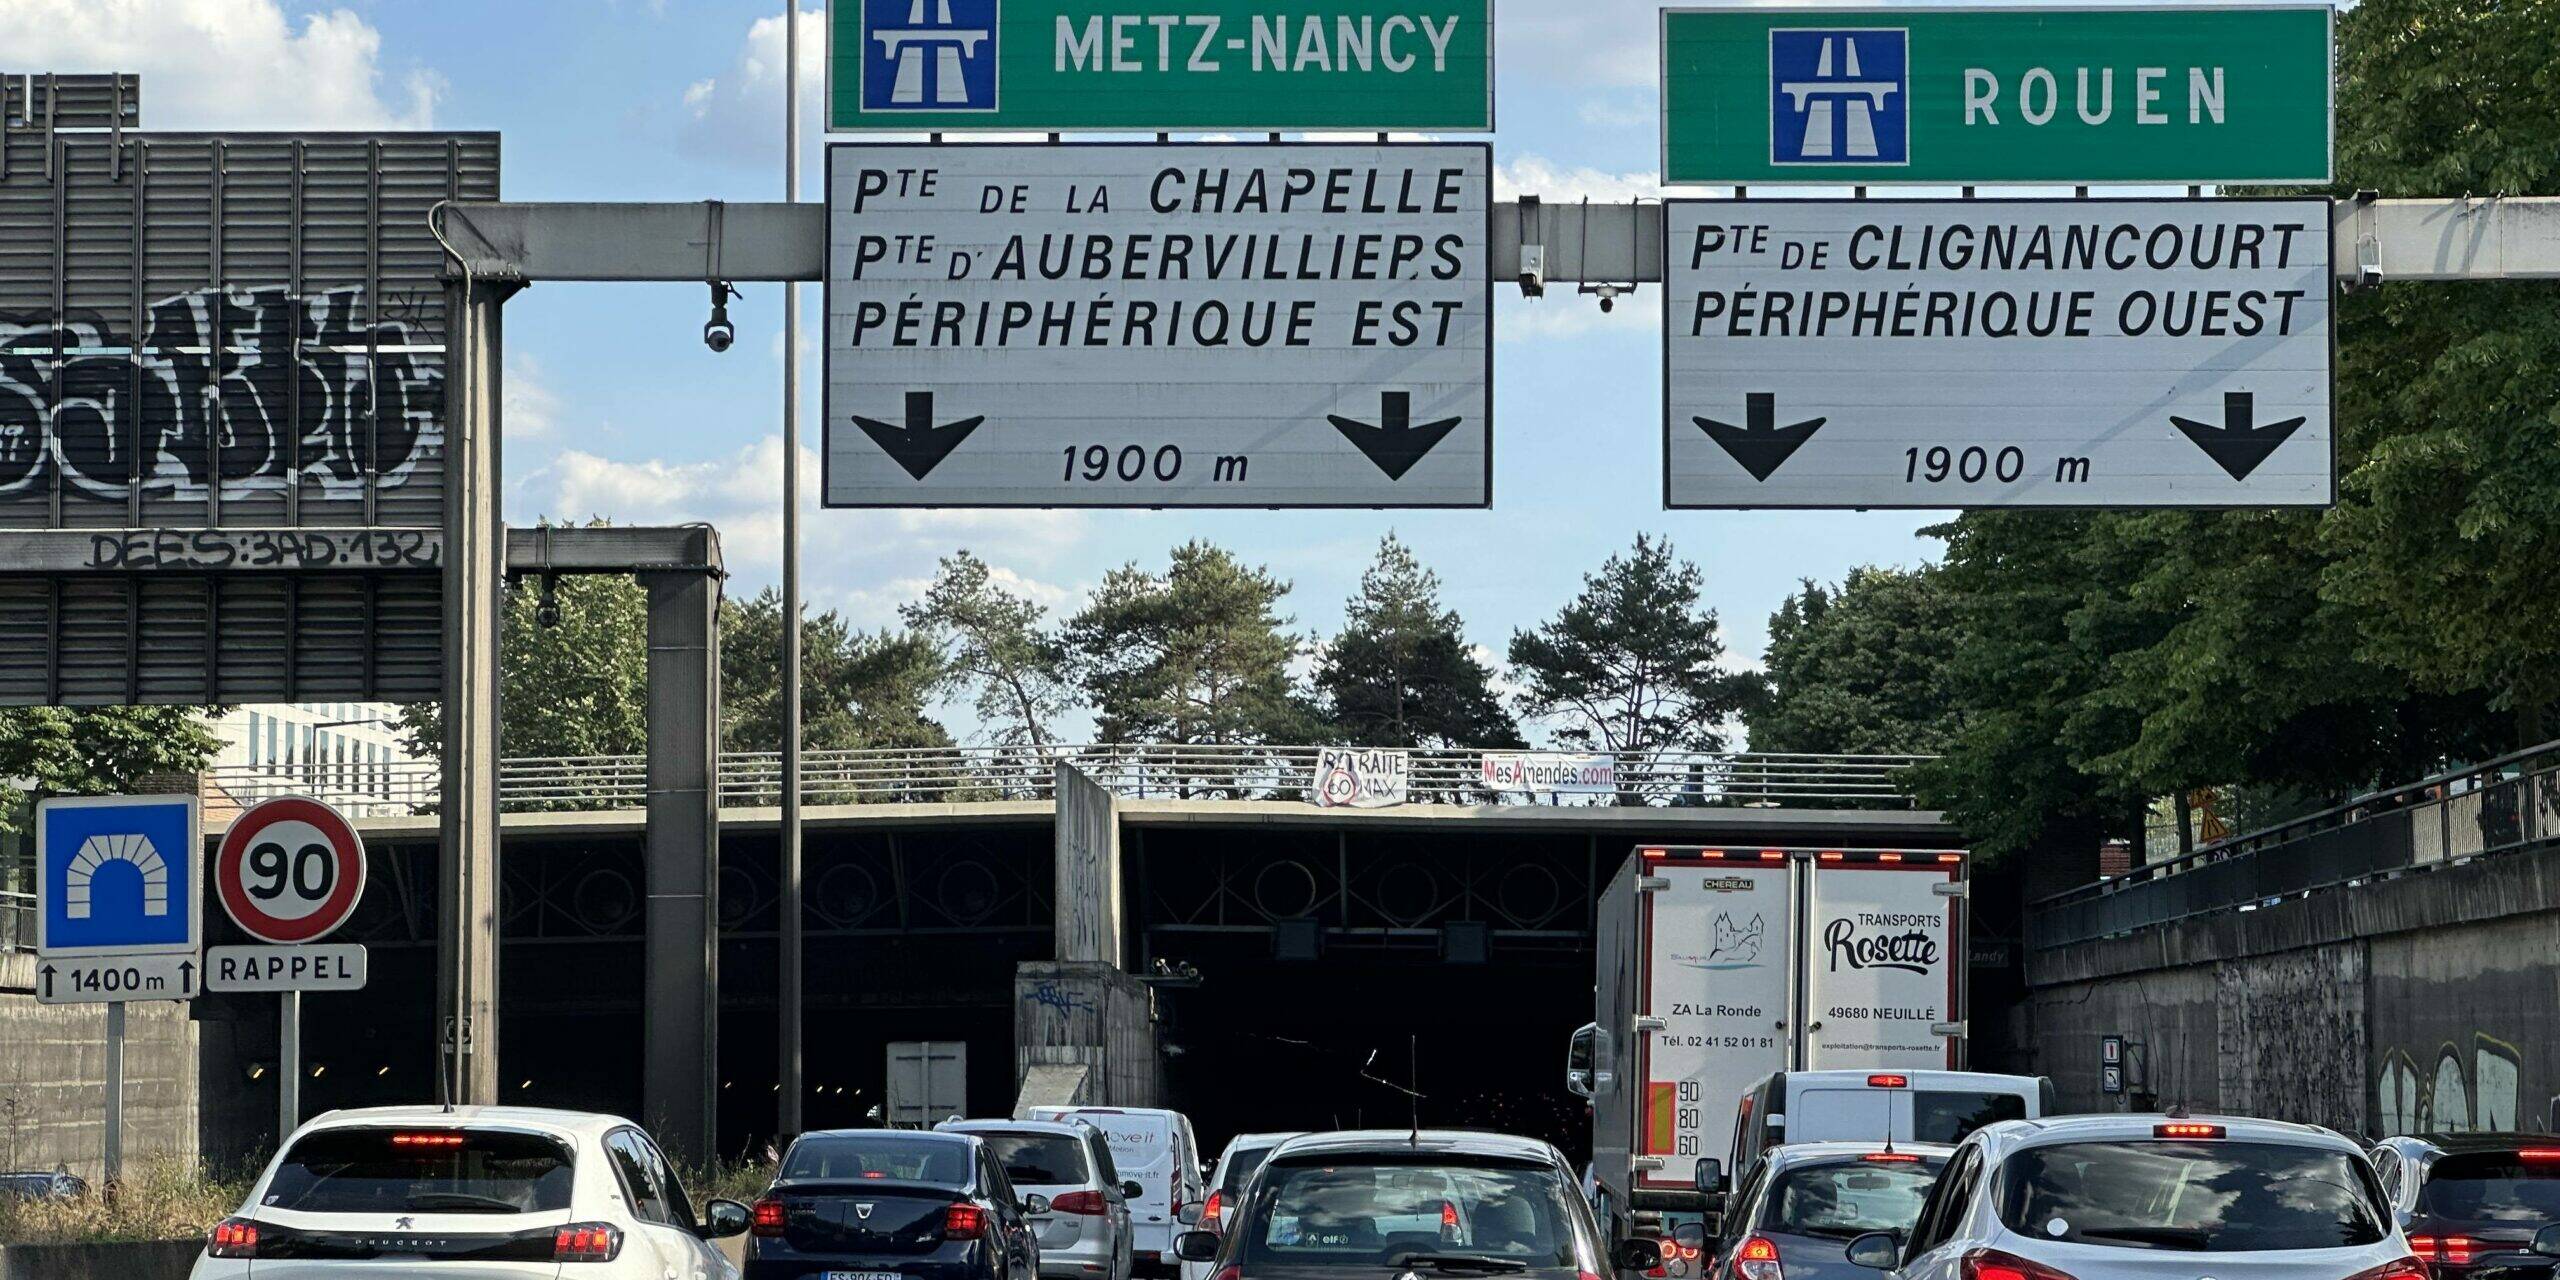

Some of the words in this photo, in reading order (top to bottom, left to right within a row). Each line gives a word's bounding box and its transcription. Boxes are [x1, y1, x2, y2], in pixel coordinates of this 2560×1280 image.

[1056, 15, 1459, 72] METZ-NANCY
[1965, 67, 2224, 125] ROUEN
[980, 186, 1028, 213] DE
[1066, 185, 1108, 213] LA
[1151, 168, 1463, 213] CHAPELLE
[1781, 242, 1829, 269] DE
[1849, 224, 2304, 270] CLIGNANCOURT
[853, 292, 1315, 346] PÉRIPHÉRIQUE
[1352, 301, 1463, 346] EST
[1692, 282, 2094, 338] PÉRIPHÉRIQUE
[2119, 290, 2305, 337] OUEST
[1064, 445, 1181, 482] 1900
[1213, 456, 1247, 482] m
[1906, 446, 2023, 483] 1900
[2056, 457, 2090, 483] m
[1323, 752, 1406, 775] RTRAITE
[1484, 760, 1612, 785] MesAmendes.com
[248, 842, 333, 900] 90
[1705, 880, 1752, 889] CHEREAU
[1858, 913, 1941, 928] TRANSPORTS
[1824, 918, 1940, 972] Rosette
[71, 968, 140, 992] 1400
[147, 977, 164, 990] m
[221, 956, 351, 980] RAPPEL
[1672, 1004, 1692, 1016] ZA
[1696, 1004, 1712, 1016] La
[1716, 1004, 1762, 1017] Ronde
[1828, 1006, 1869, 1019] 49680
[1873, 1005, 1935, 1020] NEUILLÉ
[1661, 1036, 1684, 1047] Tél.
[1687, 1036, 1702, 1047] 02
[1705, 1036, 1719, 1047] 41
[1724, 1037, 1739, 1048] 52
[1741, 1037, 1755, 1048] 01
[1760, 1038, 1773, 1048] 81
[1679, 1082, 1699, 1102] 90
[1679, 1109, 1699, 1129] 80
[1679, 1136, 1699, 1156] 60
